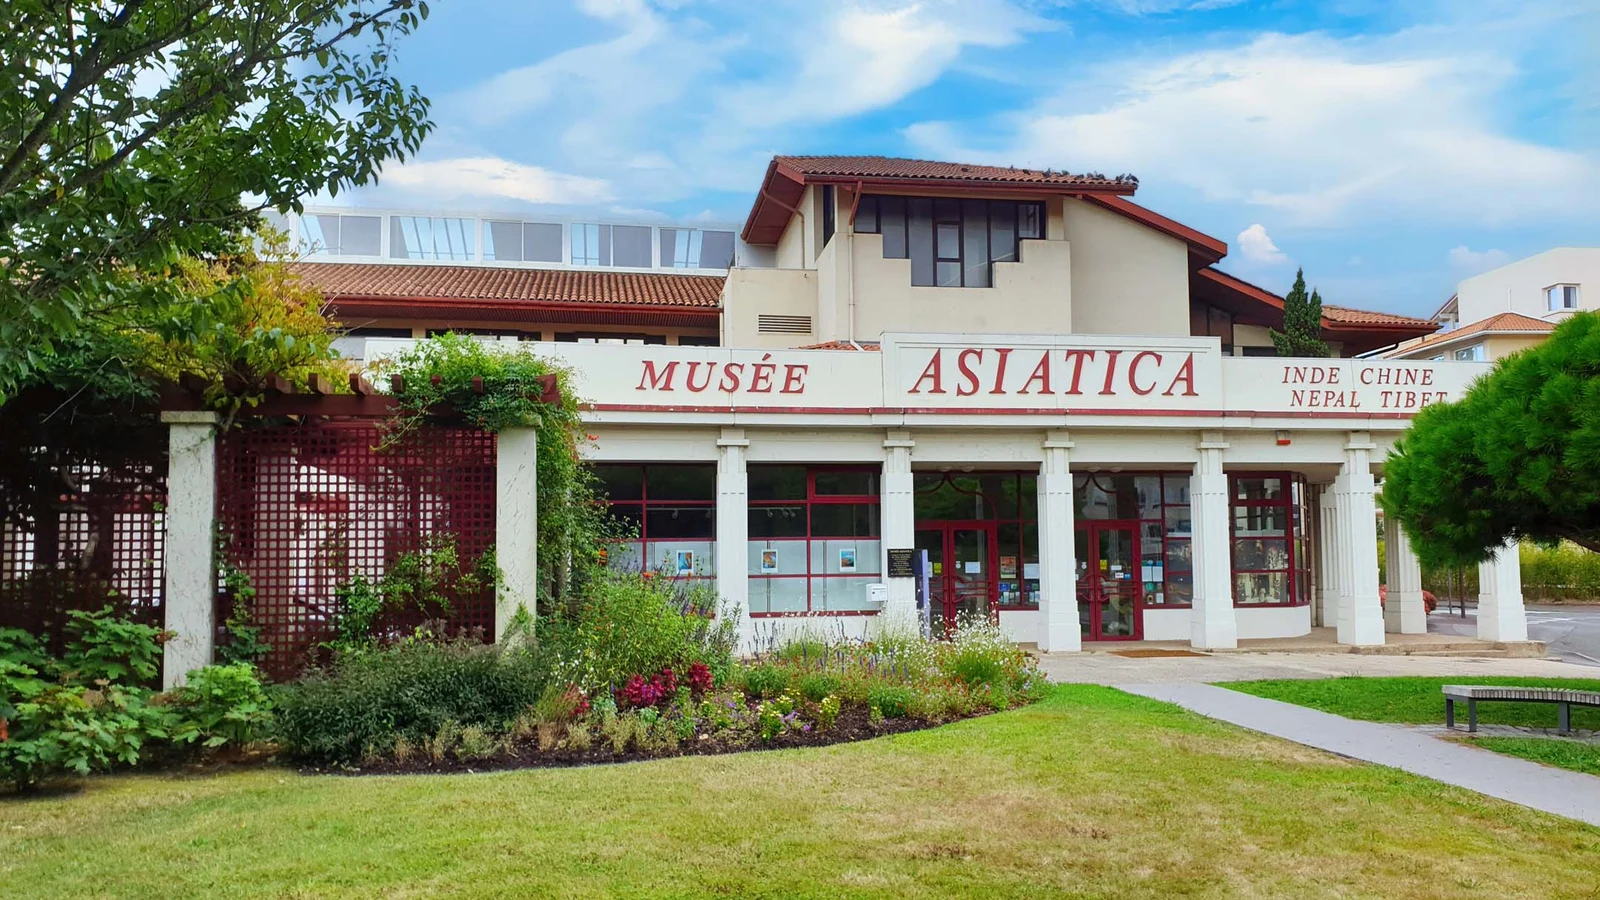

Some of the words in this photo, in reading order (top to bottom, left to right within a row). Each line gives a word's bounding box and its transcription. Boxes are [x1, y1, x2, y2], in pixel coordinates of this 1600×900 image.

[635, 353, 808, 394] MUSÉE
[907, 347, 1197, 396] ASIATICA
[1282, 367, 1340, 384] INDE
[1360, 367, 1433, 385] CHINE
[1290, 390, 1361, 408] NEPAL
[1381, 391, 1448, 408] TIBET
